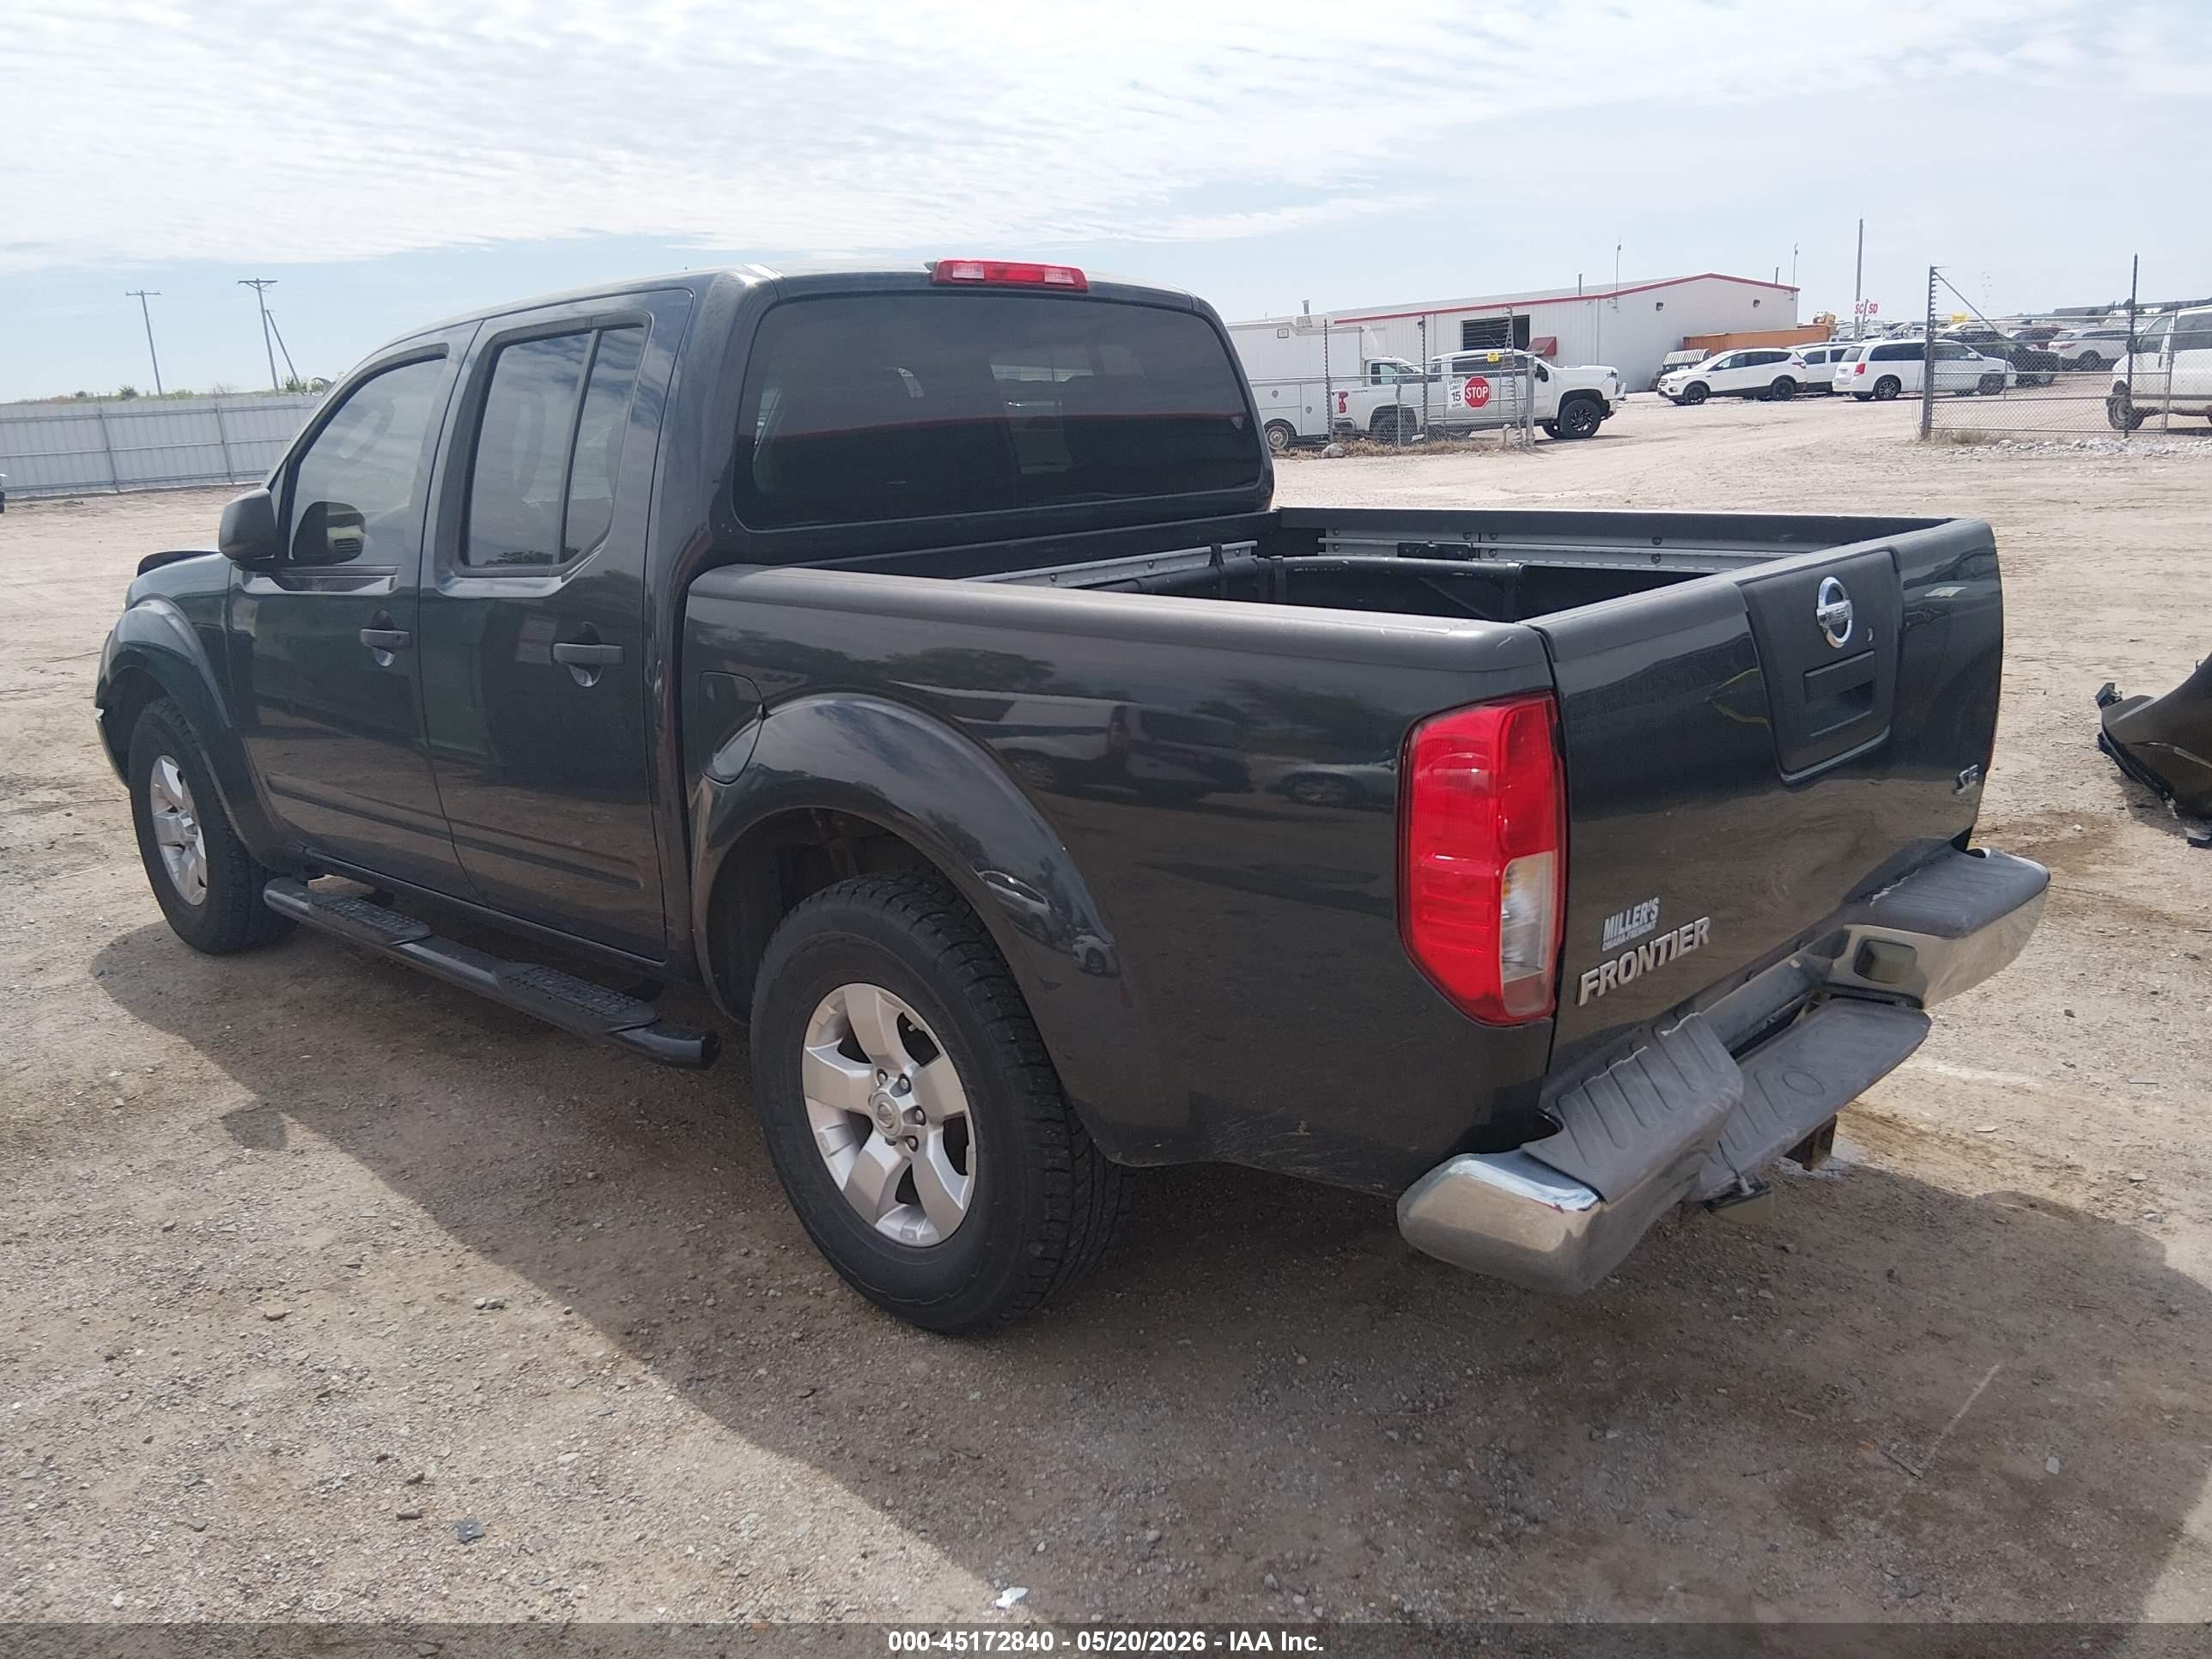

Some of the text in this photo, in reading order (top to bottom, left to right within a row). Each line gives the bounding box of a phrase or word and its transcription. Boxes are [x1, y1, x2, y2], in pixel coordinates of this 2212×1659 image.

[1869, 303, 1879, 314] SD
[1451, 392, 1462, 402] 15
[1466, 386, 1488, 399] STOP
[1603, 897, 1660, 942] MILLER'S
[1578, 916, 1711, 1006] FRONTIER
